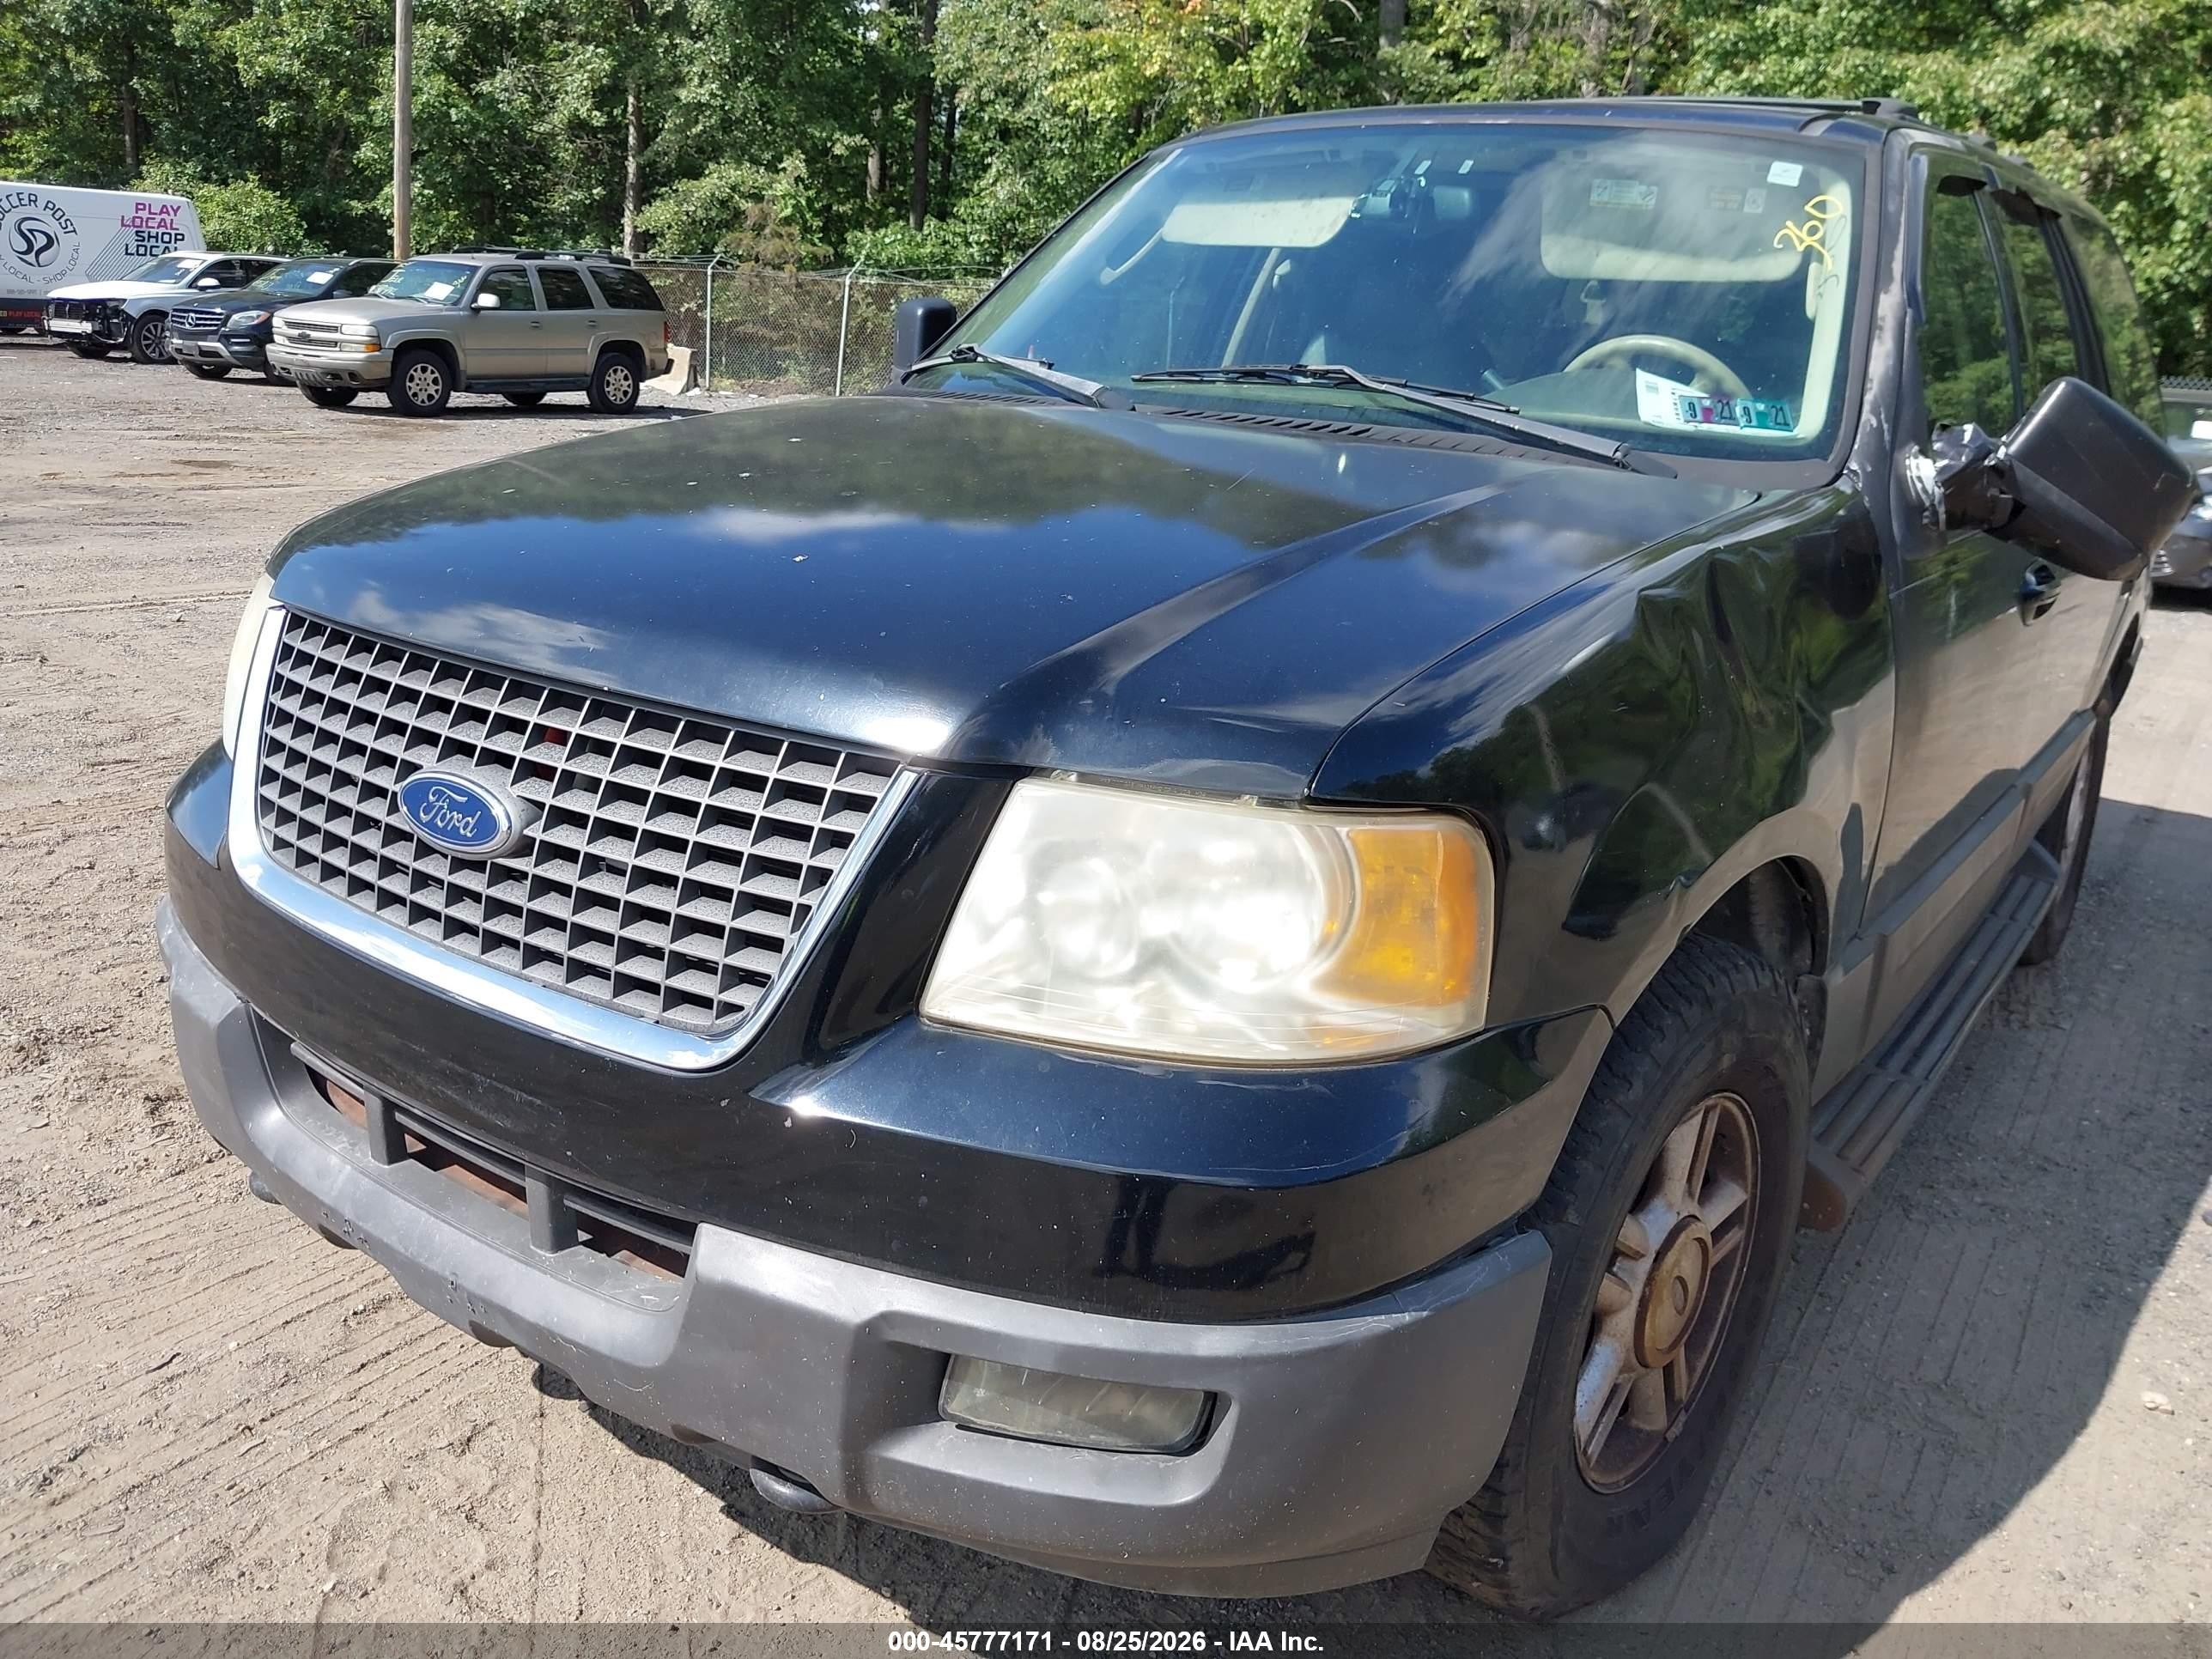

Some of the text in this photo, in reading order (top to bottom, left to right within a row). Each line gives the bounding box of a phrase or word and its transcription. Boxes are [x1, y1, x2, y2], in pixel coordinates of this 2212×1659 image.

[0, 192, 78, 235] CCER POST
[135, 202, 181, 217] PLAY
[120, 215, 179, 231] LOCAL
[135, 230, 185, 245] SHOP
[3, 261, 34, 284] LOCAL
[42, 268, 68, 284] SHOP
[67, 241, 81, 272] LOCAL
[1718, 399, 1736, 421] 21
[1771, 404, 1790, 427] 21
[419, 786, 481, 838] Ford
